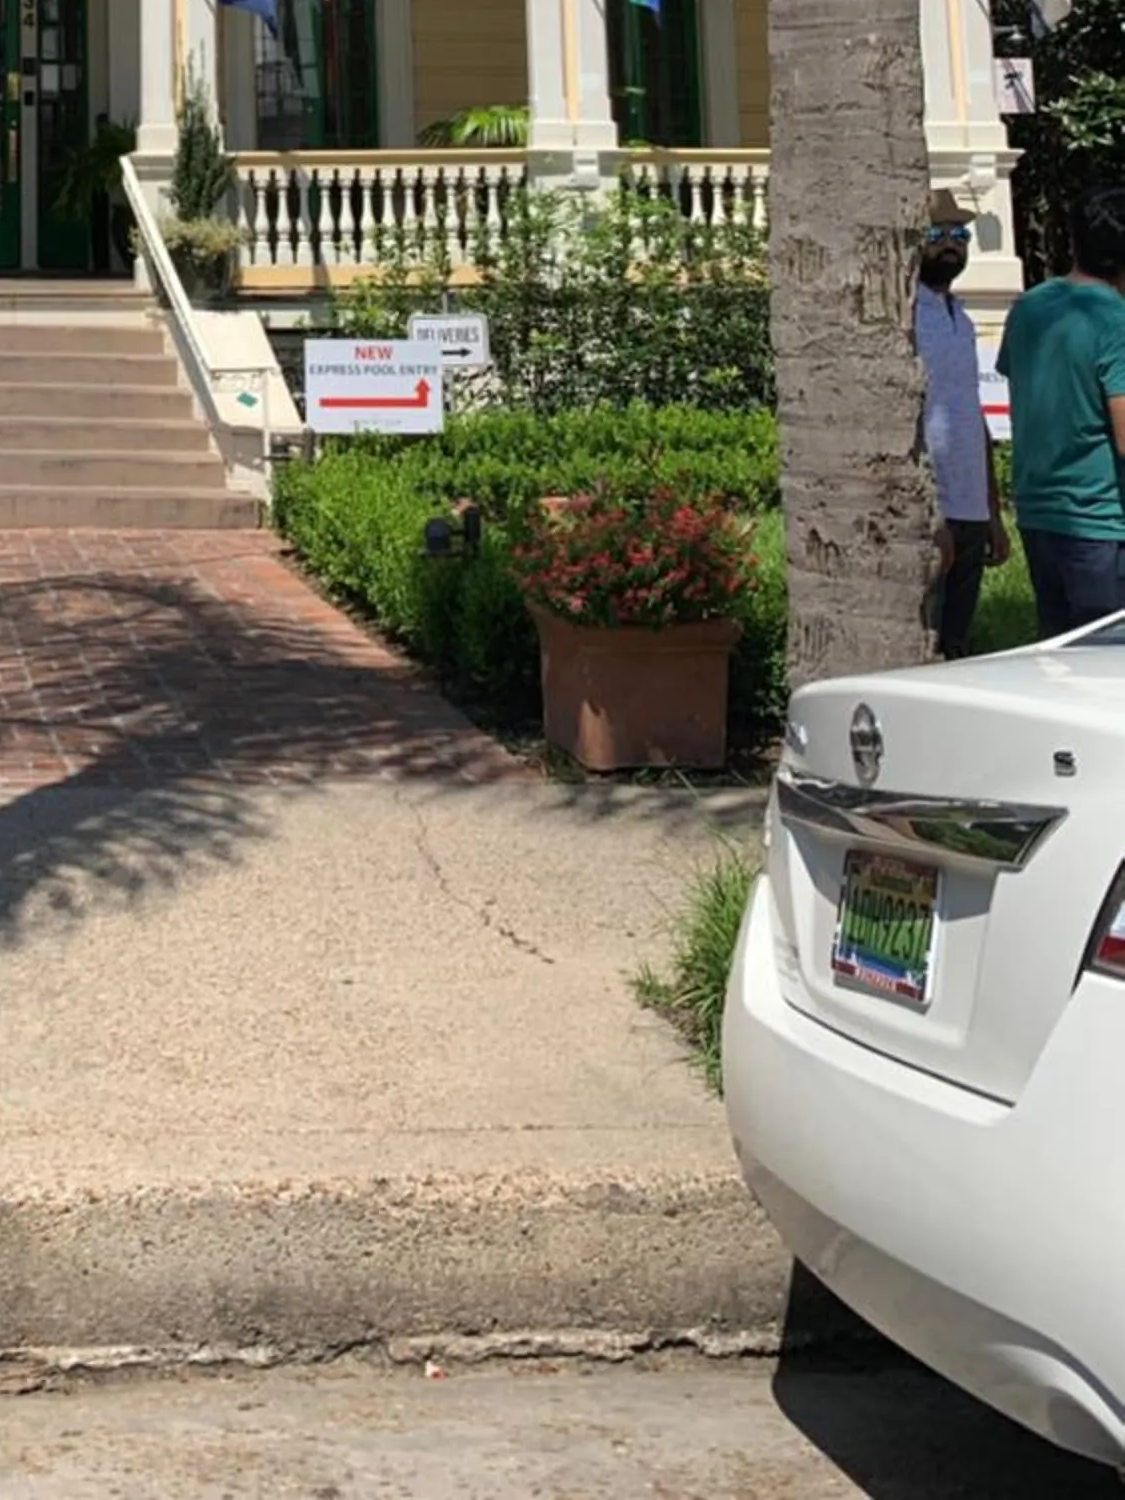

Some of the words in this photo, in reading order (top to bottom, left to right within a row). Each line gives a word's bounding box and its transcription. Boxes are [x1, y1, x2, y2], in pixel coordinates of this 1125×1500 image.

[354, 345, 394, 360] NEW
[309, 363, 362, 376] EXPRESS
[364, 364, 396, 376] POOL
[399, 363, 438, 376] ENTRY
